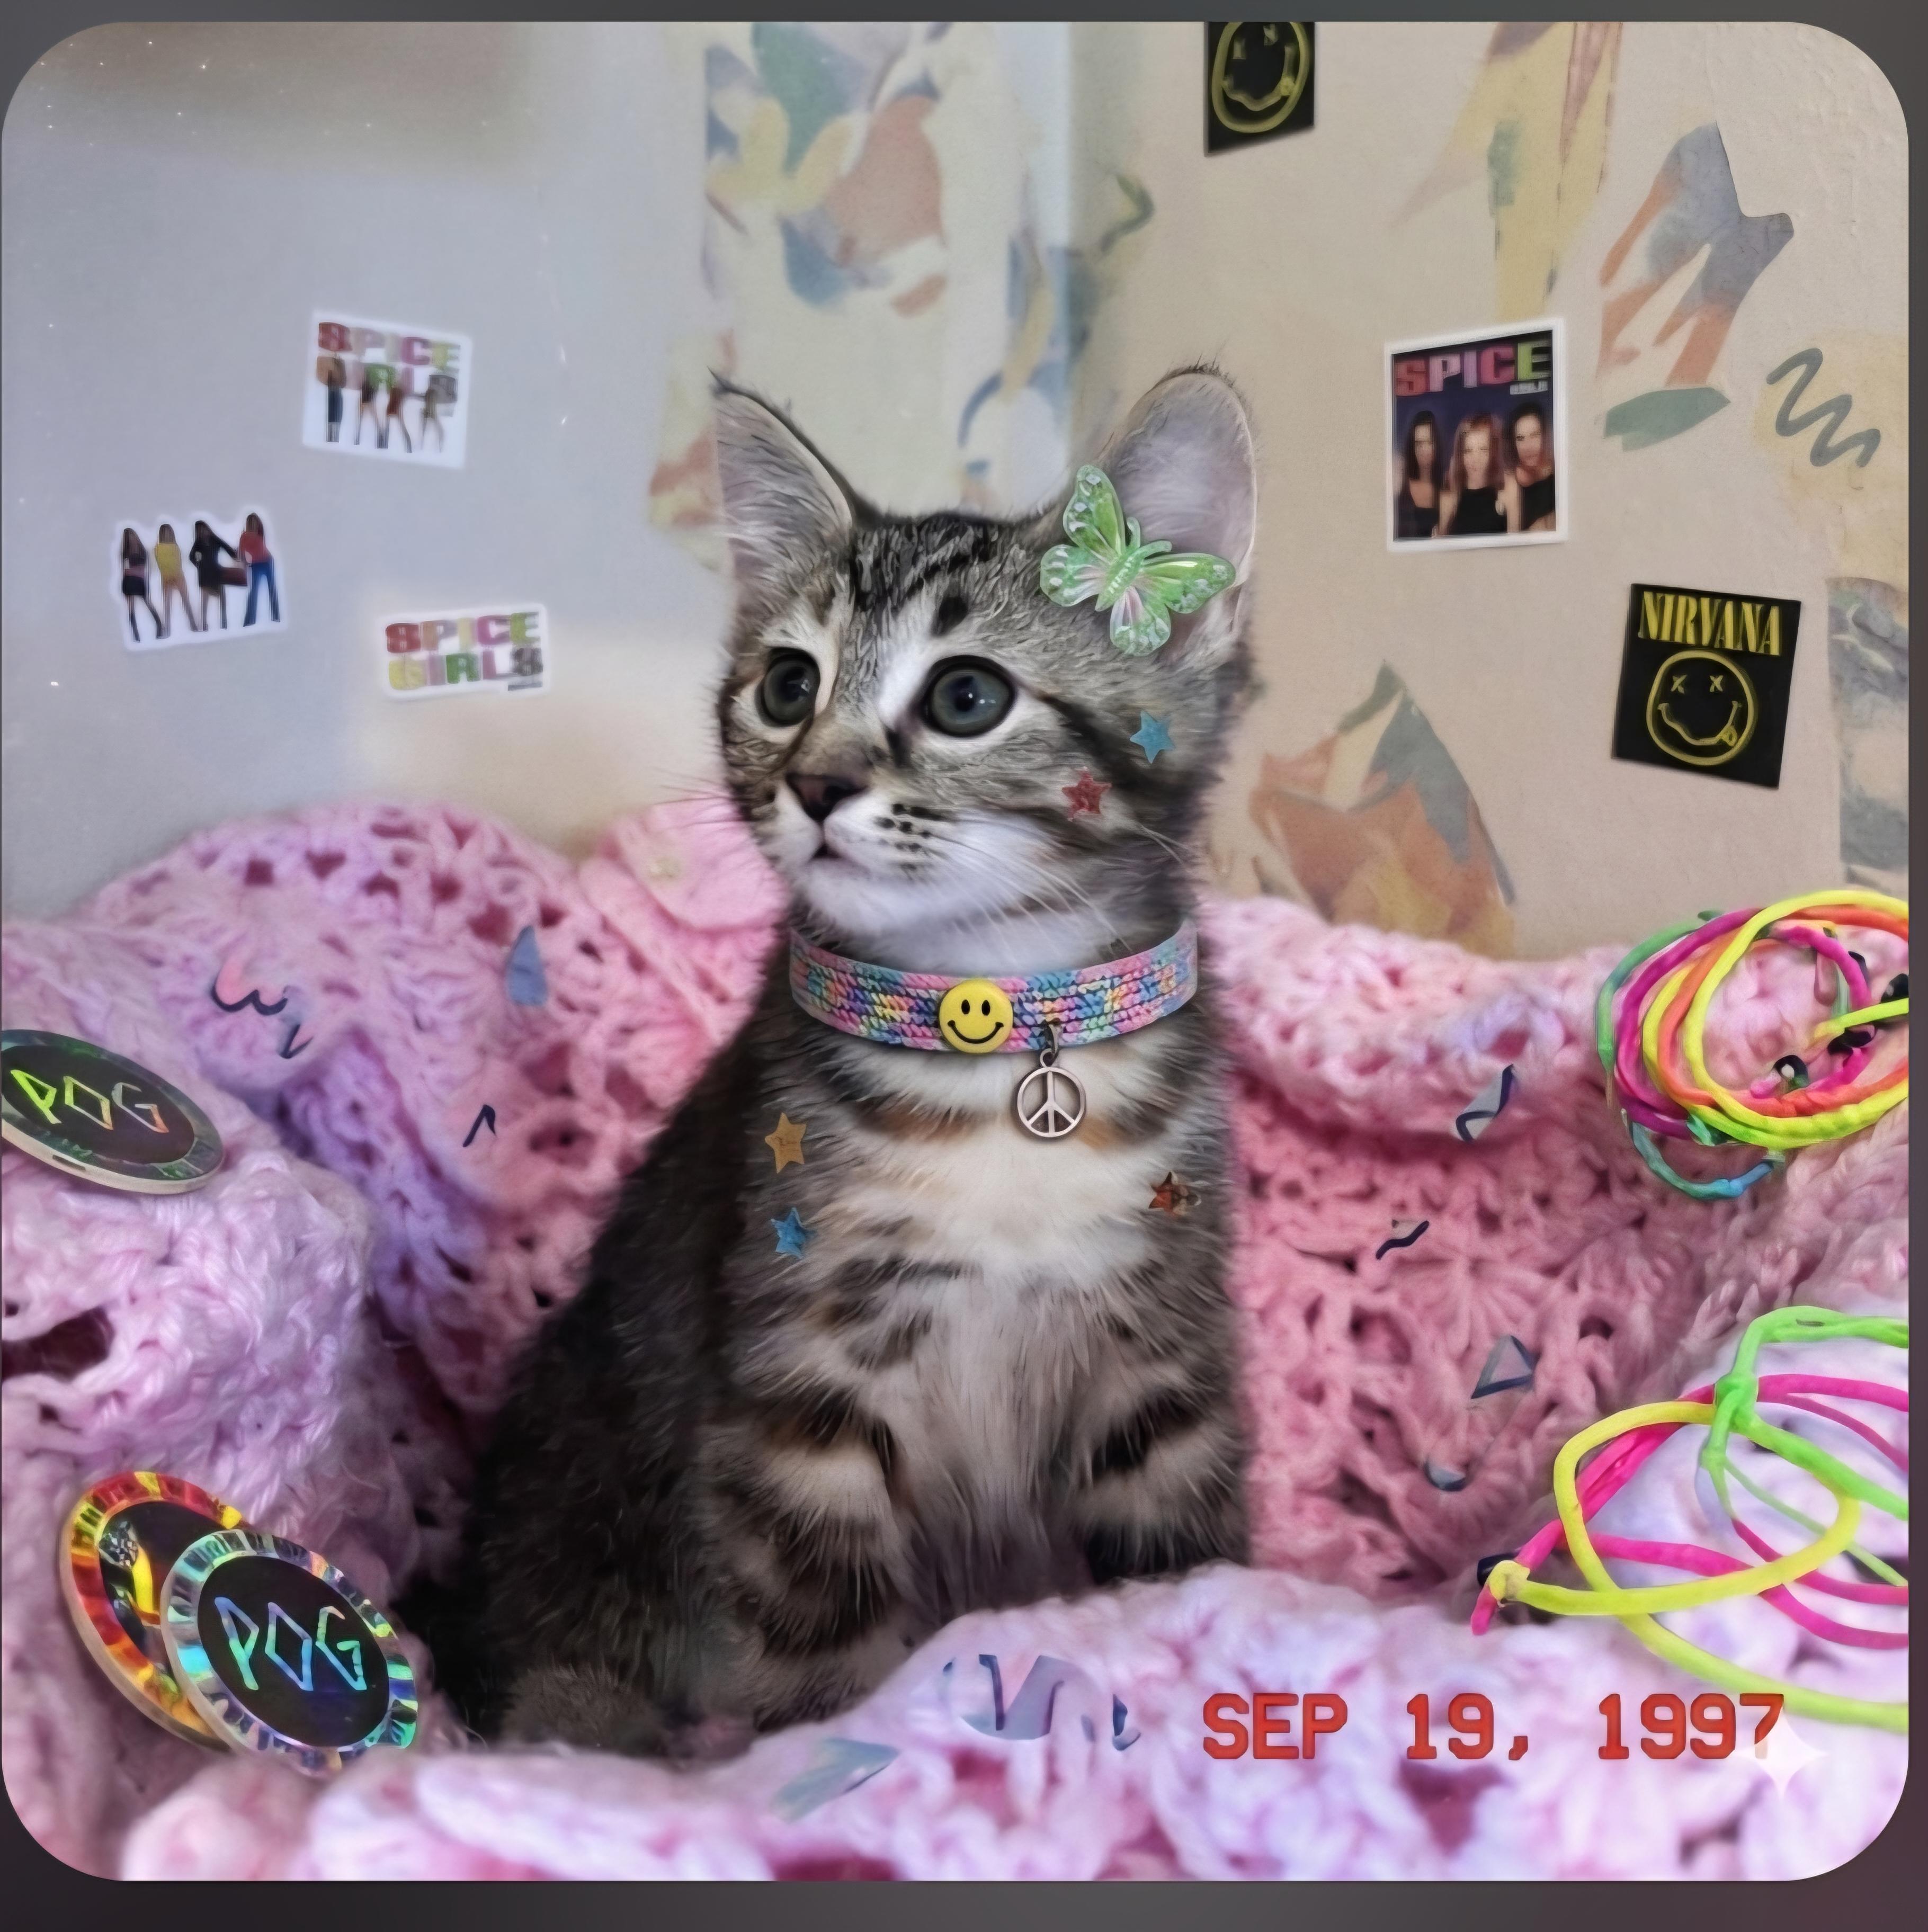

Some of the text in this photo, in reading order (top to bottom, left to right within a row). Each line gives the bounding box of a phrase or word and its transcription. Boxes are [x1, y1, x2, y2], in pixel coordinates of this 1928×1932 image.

[1395, 339, 1551, 396] SPICE
[386, 612, 540, 652] SPICE
[1638, 591, 1780, 656] NIRVANA
[10, 1069, 169, 1133] POG
[215, 1597, 367, 1691] POG
